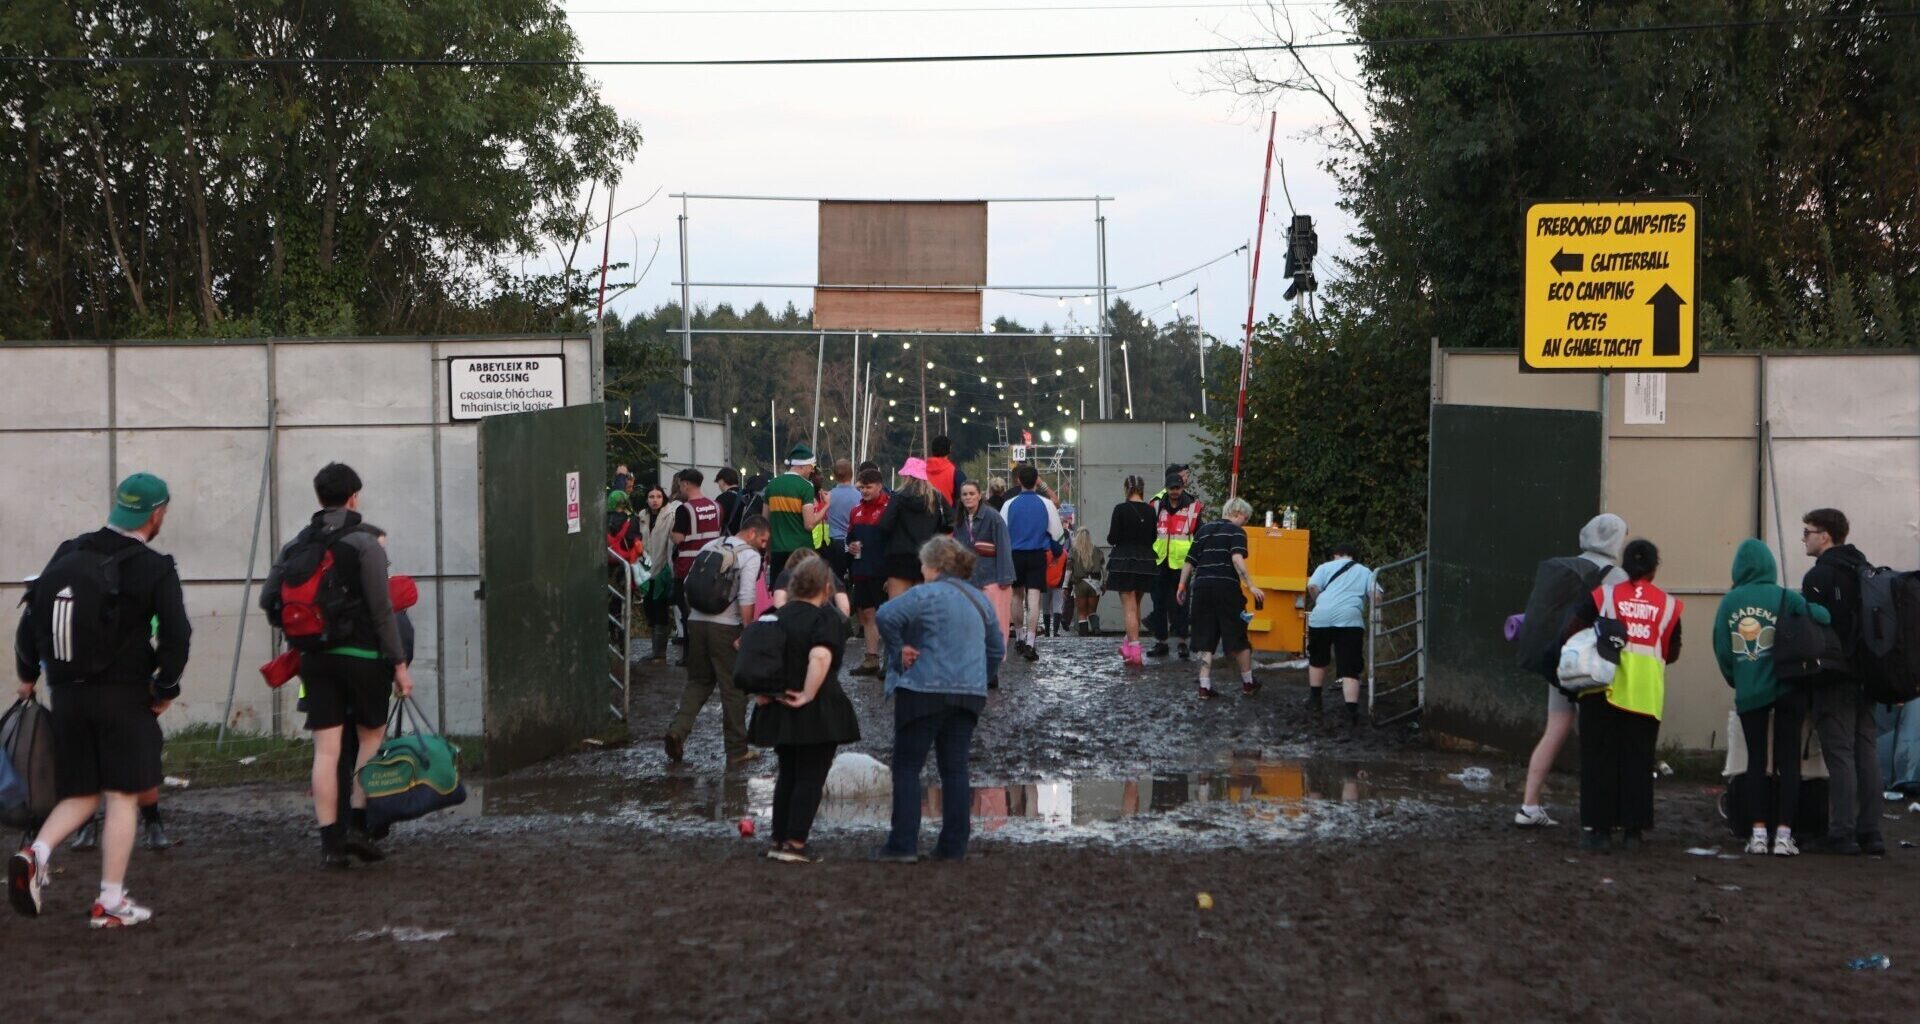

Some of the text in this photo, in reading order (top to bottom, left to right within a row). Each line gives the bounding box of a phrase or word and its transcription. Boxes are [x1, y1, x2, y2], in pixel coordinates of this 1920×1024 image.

[1536, 214, 1687, 237] PREBOOKED CAMPSITES
[1591, 251, 1669, 272] GLITTERBALL
[1548, 281, 1635, 301] ECO CAMPING
[1567, 312, 1607, 331] POETS
[1542, 338, 1642, 357] AN GHAELTACHT
[469, 362, 539, 372] ABBEYLEIX RD
[479, 373, 529, 383] CROSSING
[1014, 448, 1025, 458] 16
[1618, 601, 1659, 622] SECURITY
